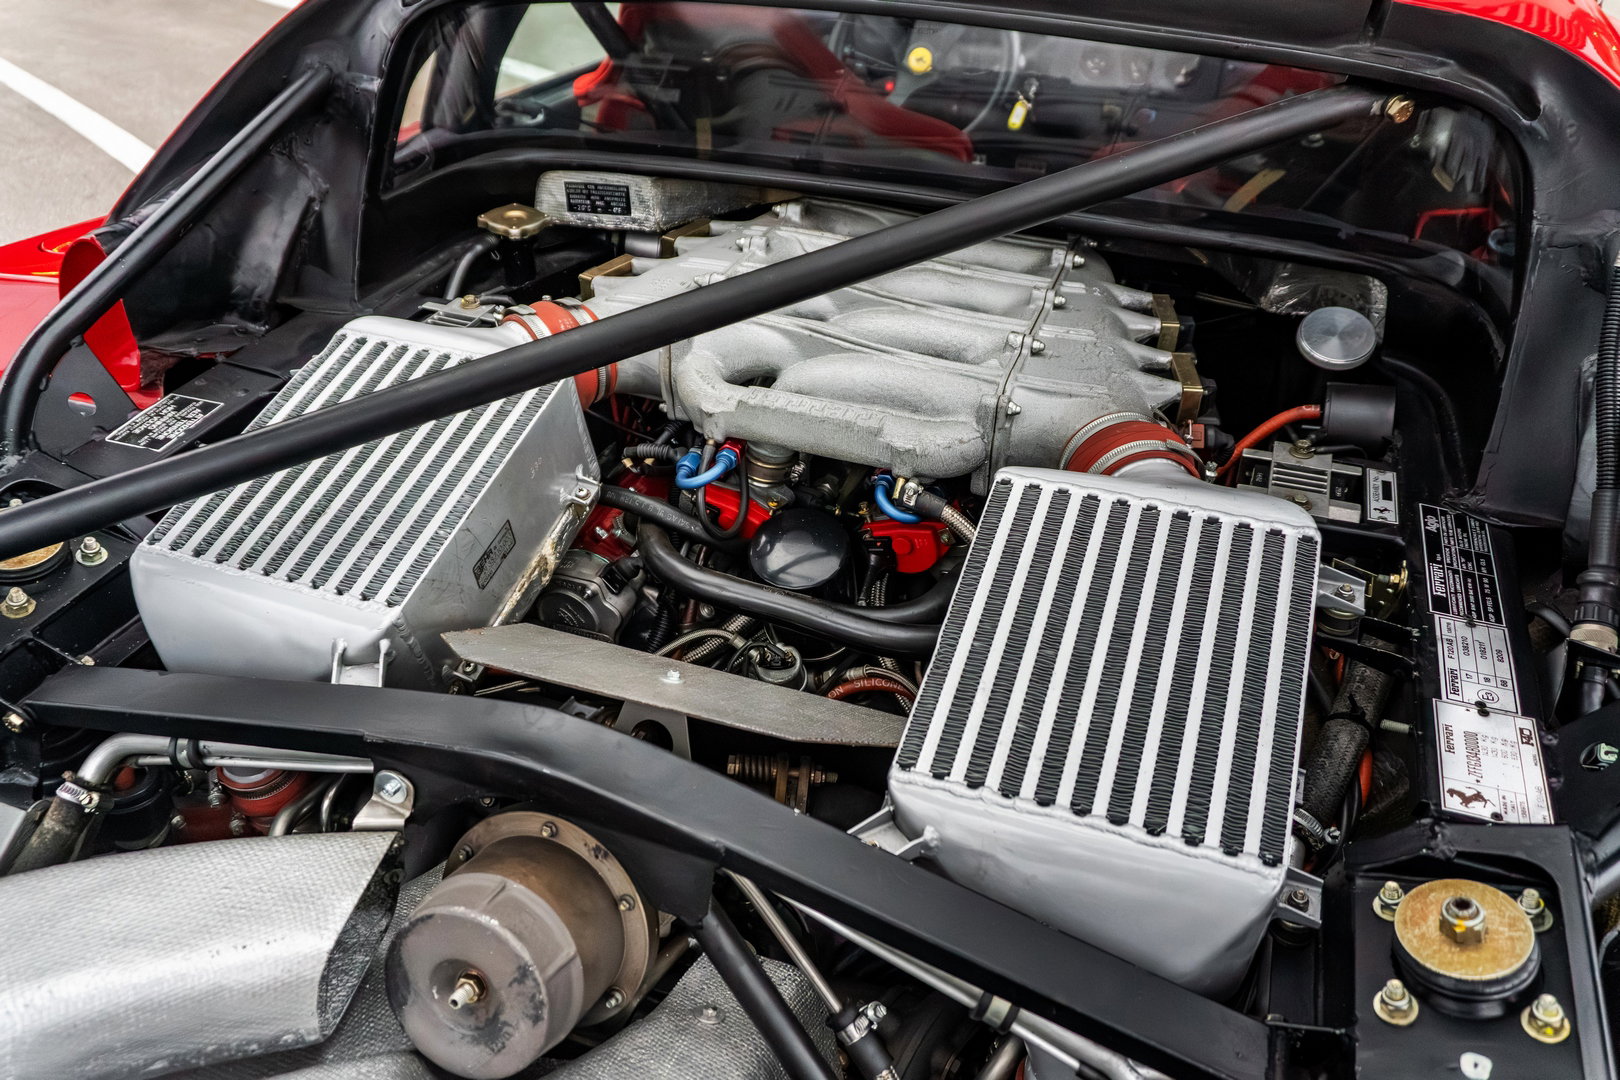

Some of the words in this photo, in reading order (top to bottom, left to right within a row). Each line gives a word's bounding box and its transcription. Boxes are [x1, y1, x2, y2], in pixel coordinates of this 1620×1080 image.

[1424, 514, 1440, 532] Agip
[1429, 561, 1447, 597] Ferrari
[1461, 635, 1470, 656] 038210
[1495, 648, 1504, 663] 8209
[853, 677, 904, 692] SILICONE
[1447, 667, 1460, 696] Ferrari
[1465, 672, 1472, 680] 17
[1442, 723, 1455, 754] Ferrari
[1518, 727, 1534, 747] F40
